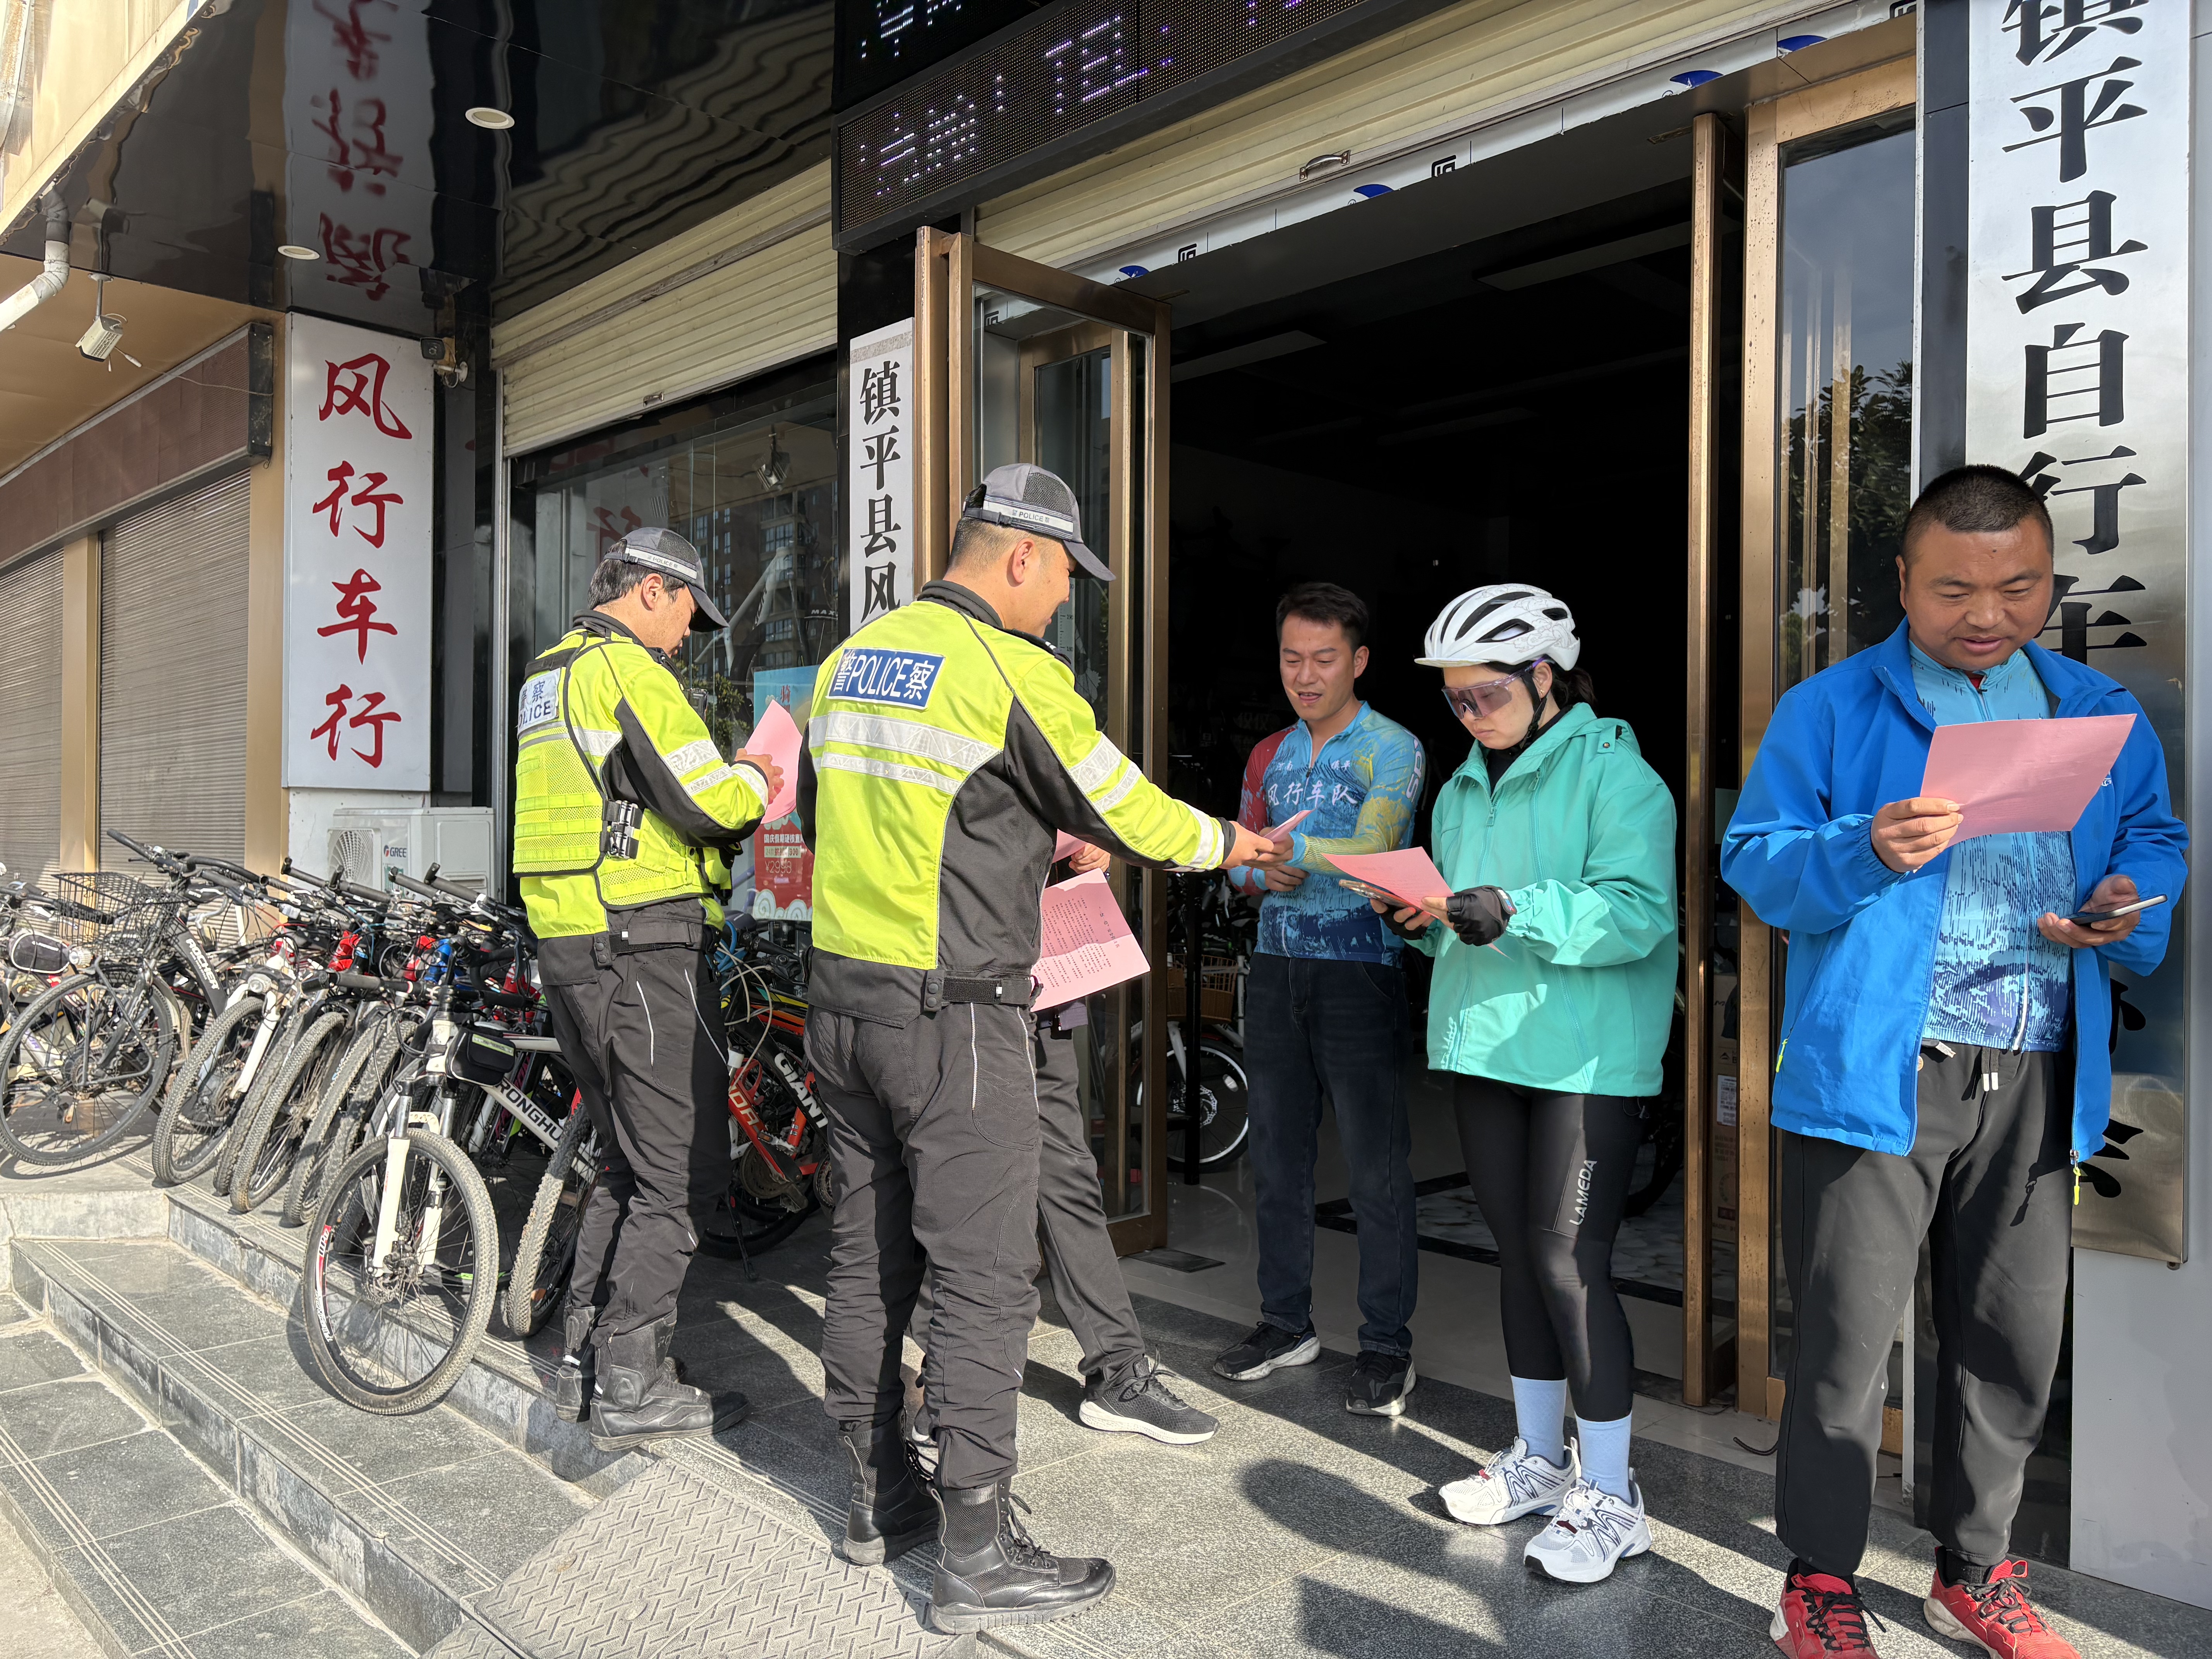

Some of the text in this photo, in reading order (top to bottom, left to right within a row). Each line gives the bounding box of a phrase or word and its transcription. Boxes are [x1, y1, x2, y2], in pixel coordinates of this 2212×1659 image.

[860, 360, 902, 623] 镇平县风
[1019, 511, 1044, 522] POLICE
[311, 352, 412, 768] 风行车行
[653, 557, 673, 566] POLICE
[1267, 780, 1358, 807] 风行车队
[390, 847, 407, 858] GREE
[186, 938, 219, 989] ROCHER
[775, 1052, 828, 1128] GIANT
[1569, 1159, 1597, 1225] LAMEDA
